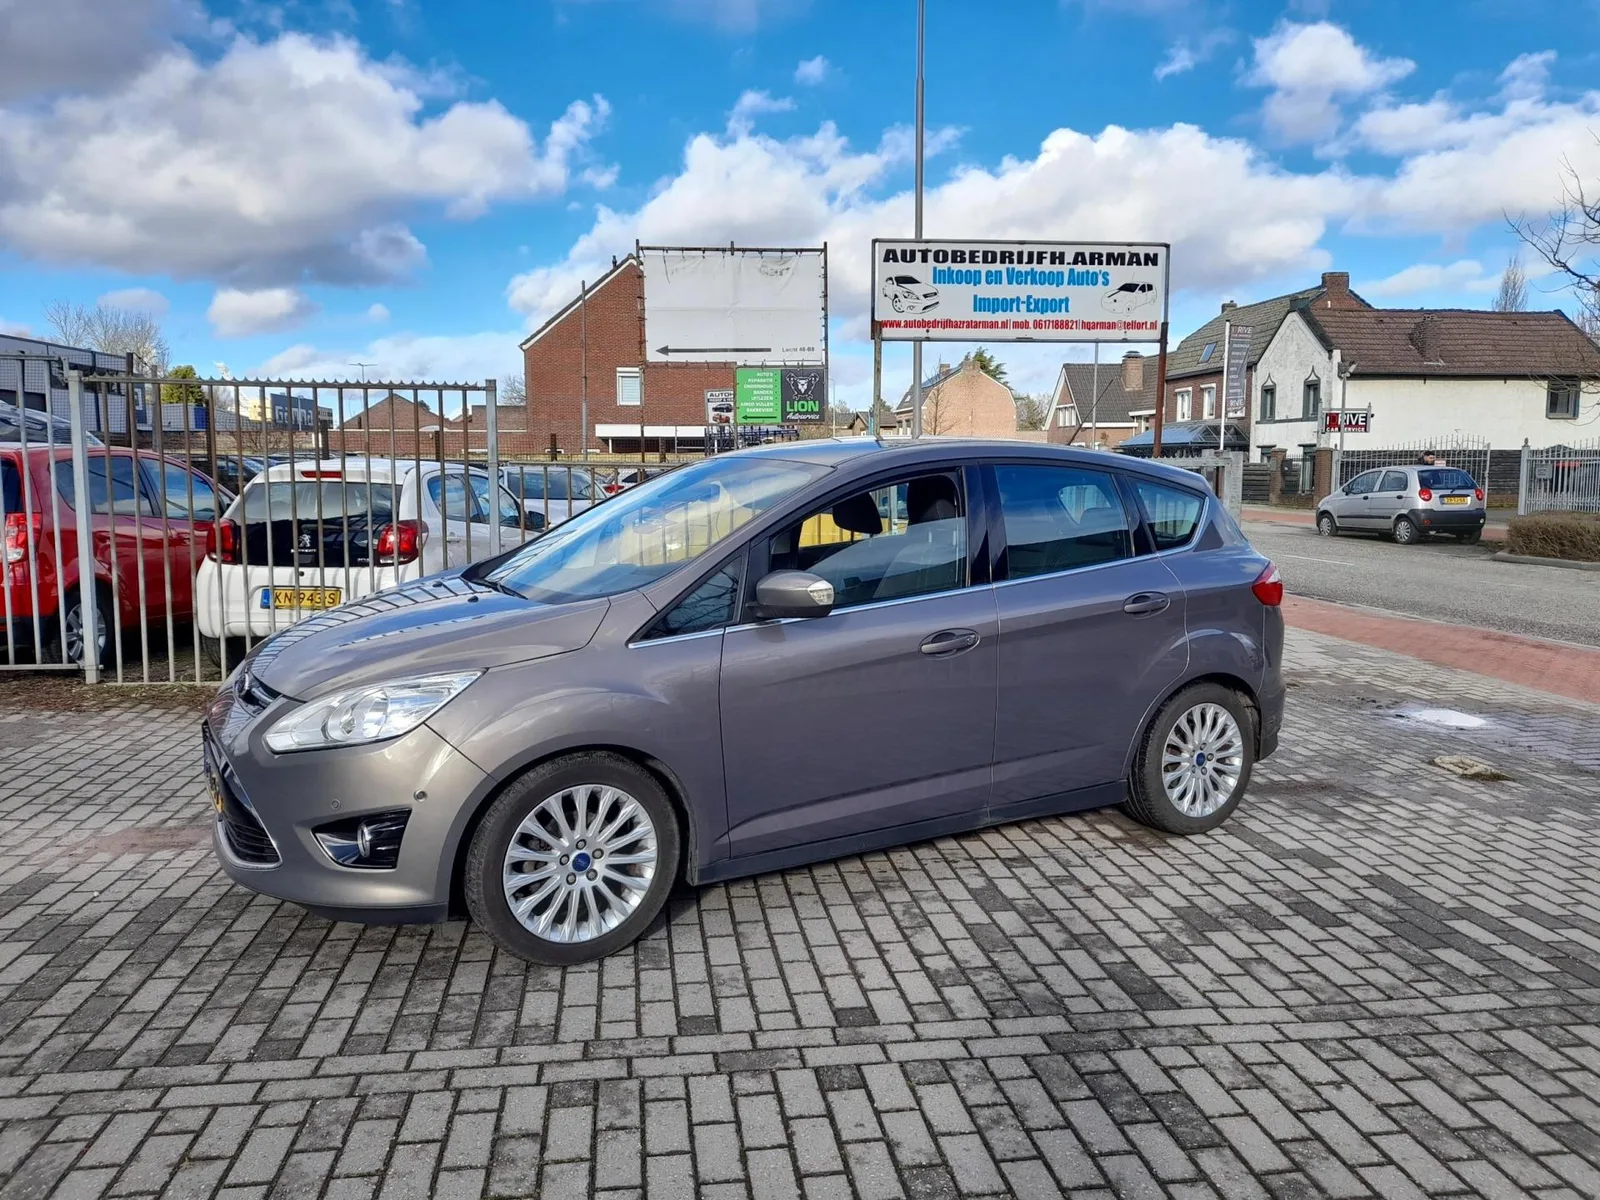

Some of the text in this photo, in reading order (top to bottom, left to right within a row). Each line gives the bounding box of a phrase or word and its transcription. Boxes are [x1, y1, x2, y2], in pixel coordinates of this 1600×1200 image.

[883, 248, 1159, 267] AUTOBEDRIJFH.ARMAN
[932, 266, 1110, 288] Inkoop en Verkoop Auto's
[973, 294, 1070, 315] Import-Export
[786, 400, 820, 413] LION
[274, 591, 336, 605] KN-943-S
